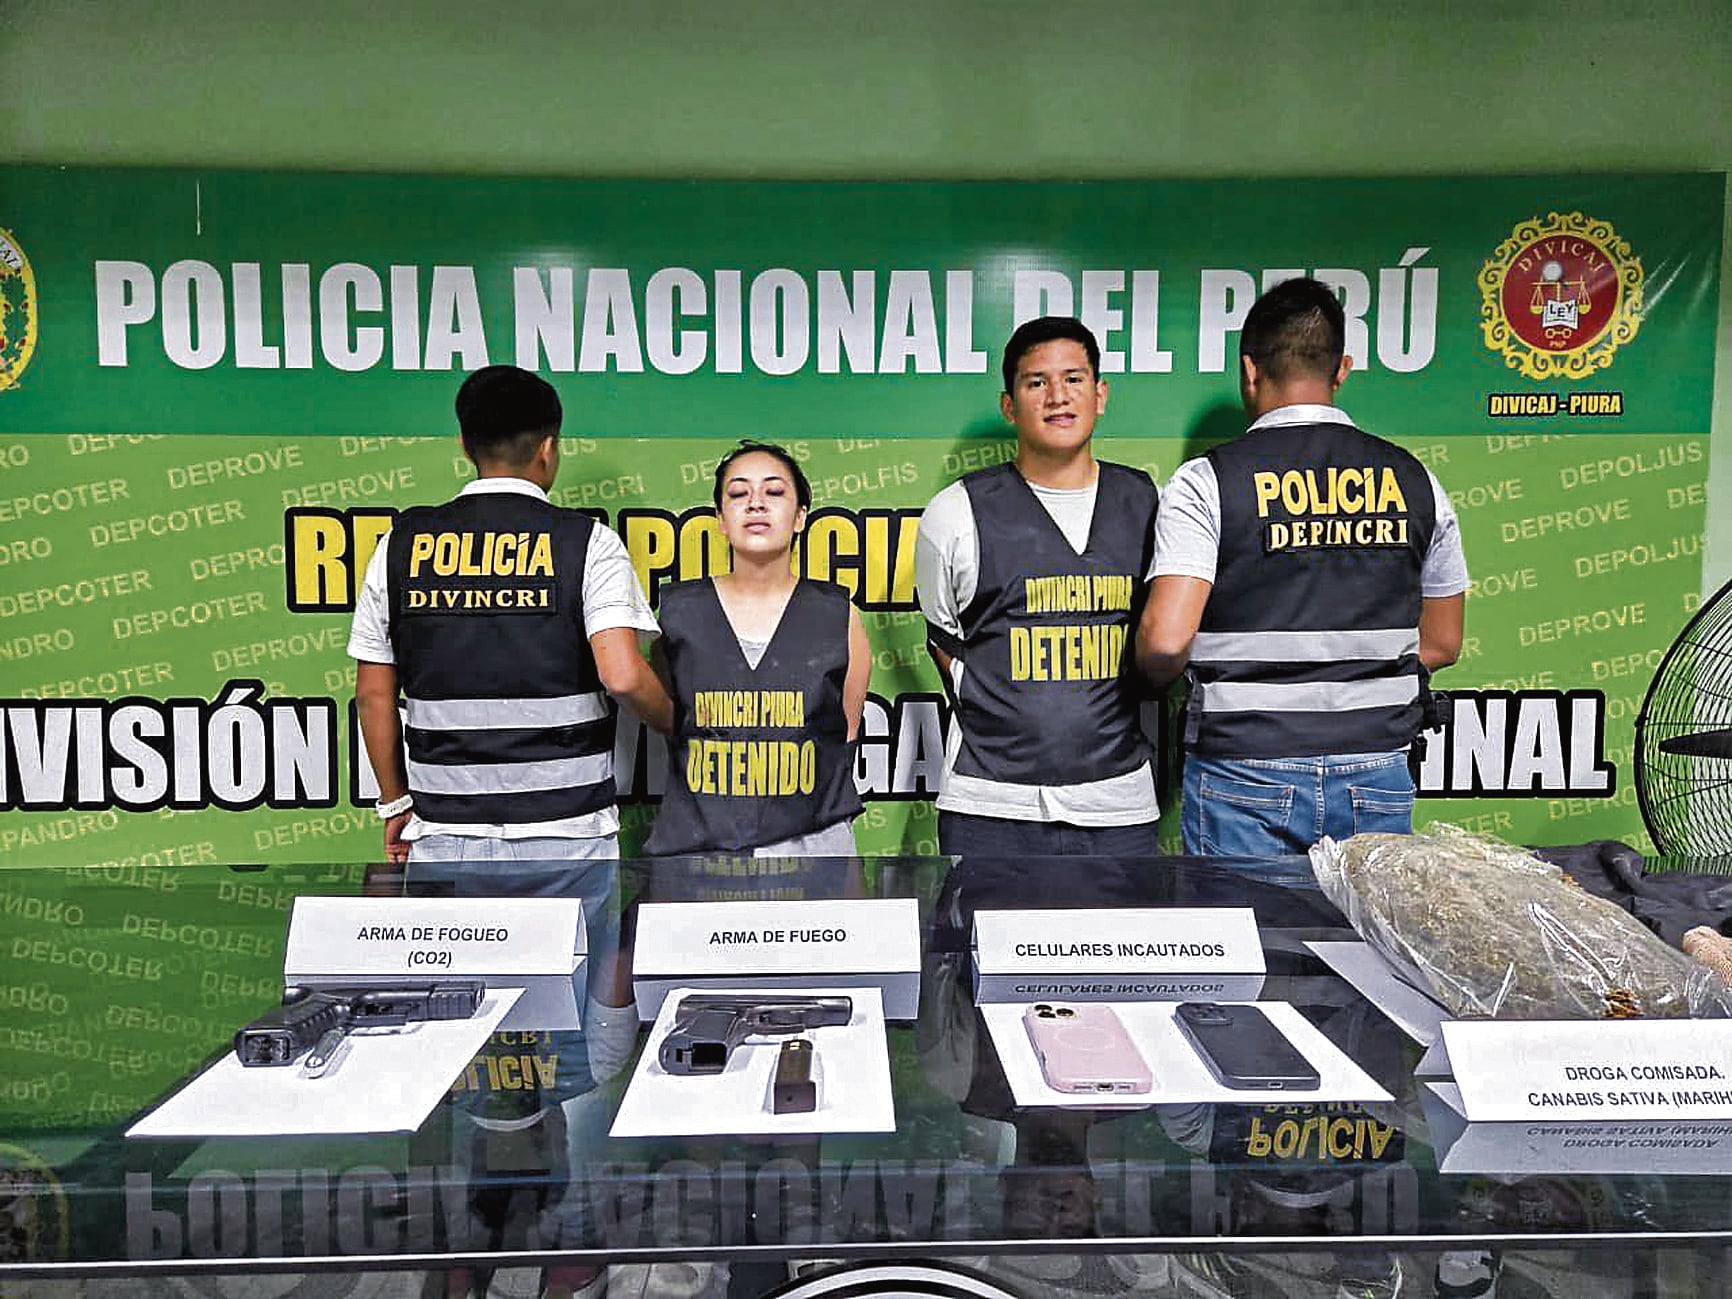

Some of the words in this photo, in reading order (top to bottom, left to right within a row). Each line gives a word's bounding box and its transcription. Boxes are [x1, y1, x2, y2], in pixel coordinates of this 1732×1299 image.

[95, 259, 490, 371] POLICIA
[513, 266, 988, 375] NACIONAL
[1198, 246, 1440, 374] PRÚ
[1549, 302, 1574, 318] LEY
[1490, 395, 1557, 415] DIVICAJ
[1569, 394, 1622, 414] PIURA
[168, 445, 304, 491] DEPROVE
[943, 443, 1018, 474] DEPIN
[1560, 441, 1703, 490] DEPOLJUS
[0, 478, 131, 523] EPCOTER
[282, 466, 417, 507] DEPROVE
[810, 463, 919, 501] EPOLFIS
[1451, 478, 1524, 510] ROVE
[89, 499, 247, 548] DEPCOTER
[1270, 519, 1409, 550] DEPINCRI
[1502, 498, 1632, 543] DEPROVE
[190, 543, 285, 582] DEPRO
[408, 589, 549, 609] DIVINCRI
[1467, 568, 1538, 599] ROVE
[112, 591, 270, 640] DEPCOTER
[1519, 603, 1647, 648] DEPROVE
[211, 627, 346, 673] DEPROVE
[695, 690, 759, 728] DIVINCRI
[760, 690, 805, 728] PIURA
[0, 688, 329, 803] VISIÓN
[687, 739, 816, 796] DETENIDO
[2, 811, 119, 852] PANDRO
[356, 927, 406, 941] ARMA
[411, 927, 434, 941] DE
[438, 927, 509, 942] FOGUEO
[709, 930, 759, 945] ARMA
[763, 930, 785, 943] DE
[789, 929, 847, 943] FUEGO
[1015, 943, 1114, 957] CELULARES
[1118, 943, 1226, 957] INCAUTADOS
[407, 950, 453, 968] (CO2)
[1565, 1066, 1628, 1081] DROGA
[1630, 1065, 1726, 1080] COMISADA.
[1528, 1092, 1605, 1107] CANABIS
[1607, 1091, 1670, 1106] SATIVA
[1672, 1091, 1732, 1109] (MARIH
